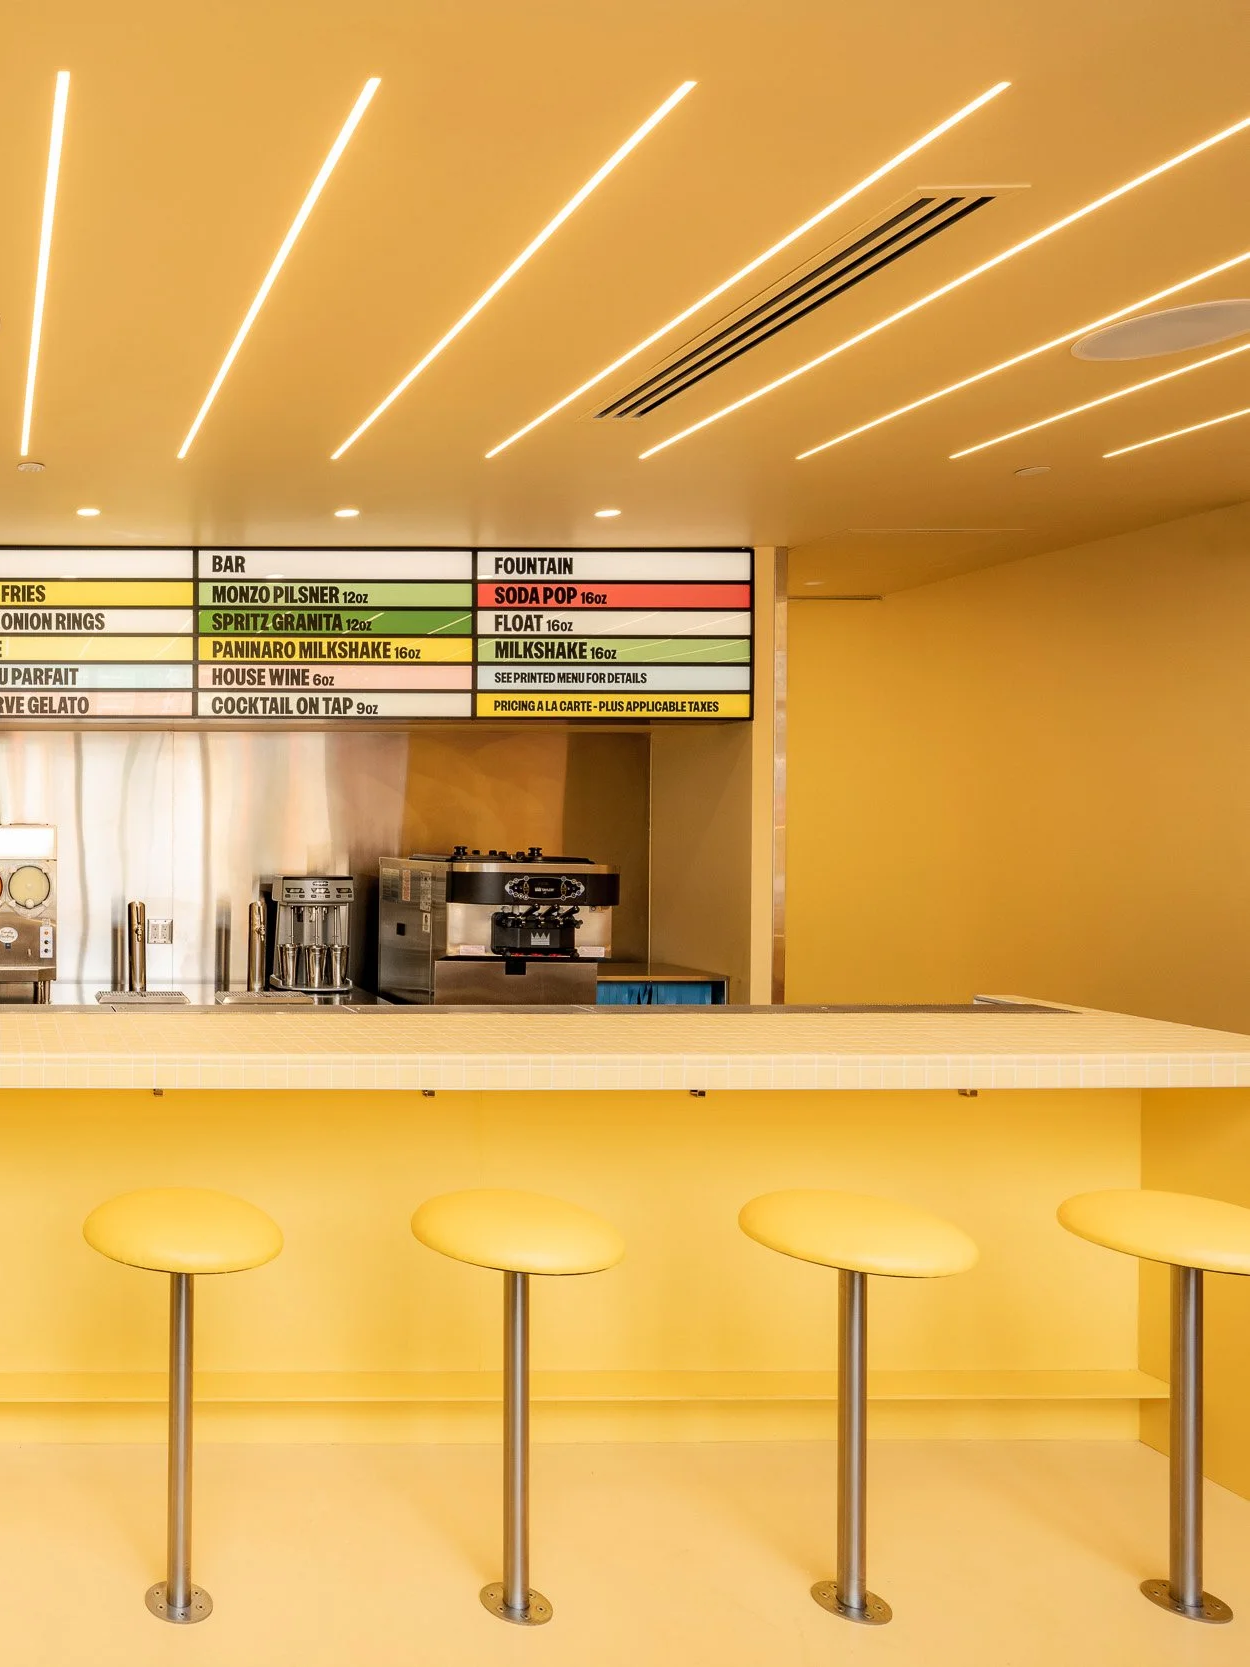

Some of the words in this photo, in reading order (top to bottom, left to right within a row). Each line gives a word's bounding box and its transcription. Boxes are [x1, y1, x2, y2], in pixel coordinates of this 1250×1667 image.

[212, 556, 246, 572] BAR
[494, 557, 574, 574] FOUNTAIN
[1, 585, 46, 602] FRIES
[212, 586, 271, 603] MONZO
[273, 586, 340, 603] PILSNER
[342, 592, 369, 603] 12oz
[494, 587, 541, 604] SODA
[542, 587, 578, 604] POP
[580, 592, 607, 604] 16oz
[0, 613, 53, 630] ONION
[55, 613, 105, 630] RINGS
[211, 613, 270, 630] SPRITZ
[271, 614, 344, 631] GRANITA
[345, 619, 373, 631] 12oz
[494, 615, 544, 631] FLOAT
[546, 620, 574, 631] 16oz
[211, 641, 296, 658] PANINARO
[298, 641, 392, 658] MILKSHAKE
[394, 647, 421, 659] 16oz
[494, 641, 588, 659] MILKSHAKE
[589, 647, 617, 659] 16oz
[11, 668, 79, 685] PARFAIT
[212, 668, 266, 685] HOUSE
[268, 669, 310, 685] WINE
[312, 674, 335, 686] 6oz
[494, 672, 513, 683] SEE
[513, 673, 556, 683] PRINTED
[557, 673, 585, 683] MENU
[586, 673, 606, 683] FOR
[607, 673, 648, 683] DETAILS
[27, 697, 90, 714] GELATO
[211, 697, 294, 714] COCKTAIL
[296, 697, 320, 714] ON
[321, 697, 354, 714] TAP
[356, 703, 379, 714] 9oz
[493, 701, 536, 711] PRICING
[536, 701, 544, 711] A
[545, 701, 558, 711] LA
[559, 701, 593, 711] CARTE
[598, 701, 626, 711] PLUS
[625, 701, 687, 712] APPLICABLE
[687, 702, 720, 712] TAXES
